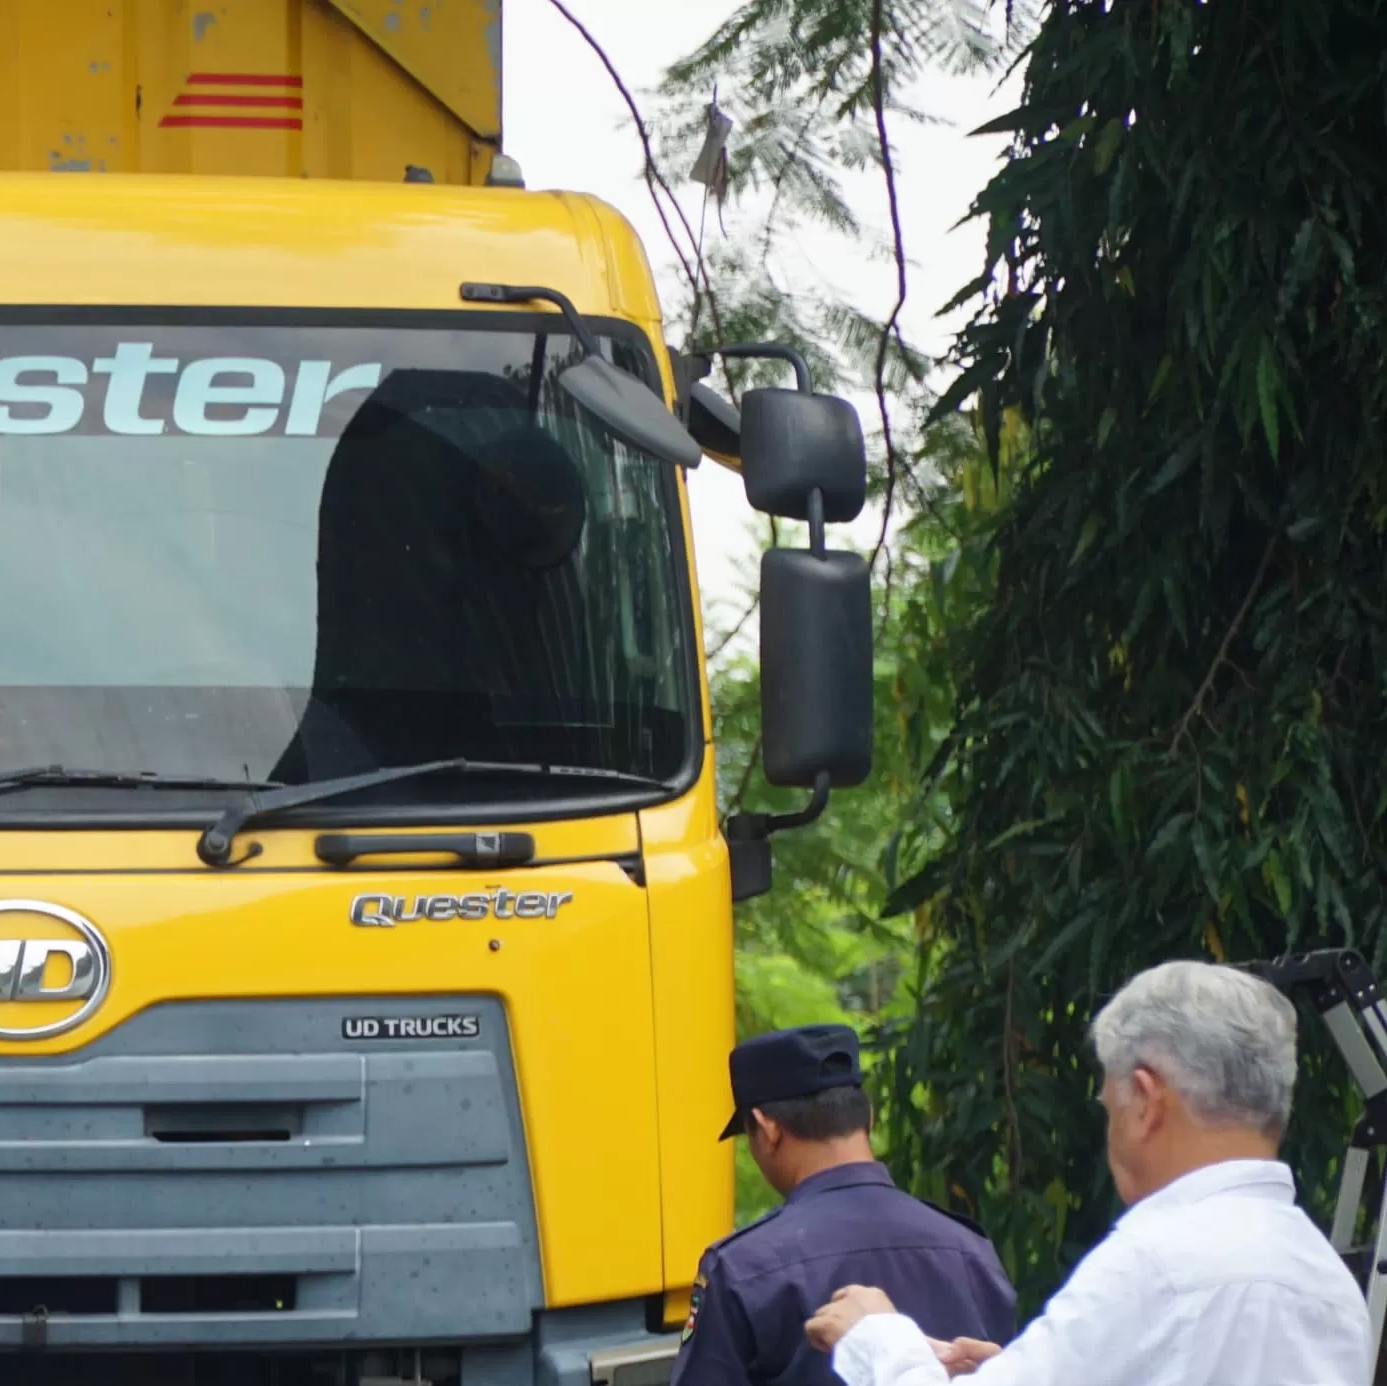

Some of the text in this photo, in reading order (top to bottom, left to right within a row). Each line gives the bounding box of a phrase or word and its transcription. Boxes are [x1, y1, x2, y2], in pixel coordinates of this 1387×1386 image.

[350, 887, 574, 927] Quester
[345, 1016, 478, 1037] UD TRUCKS
